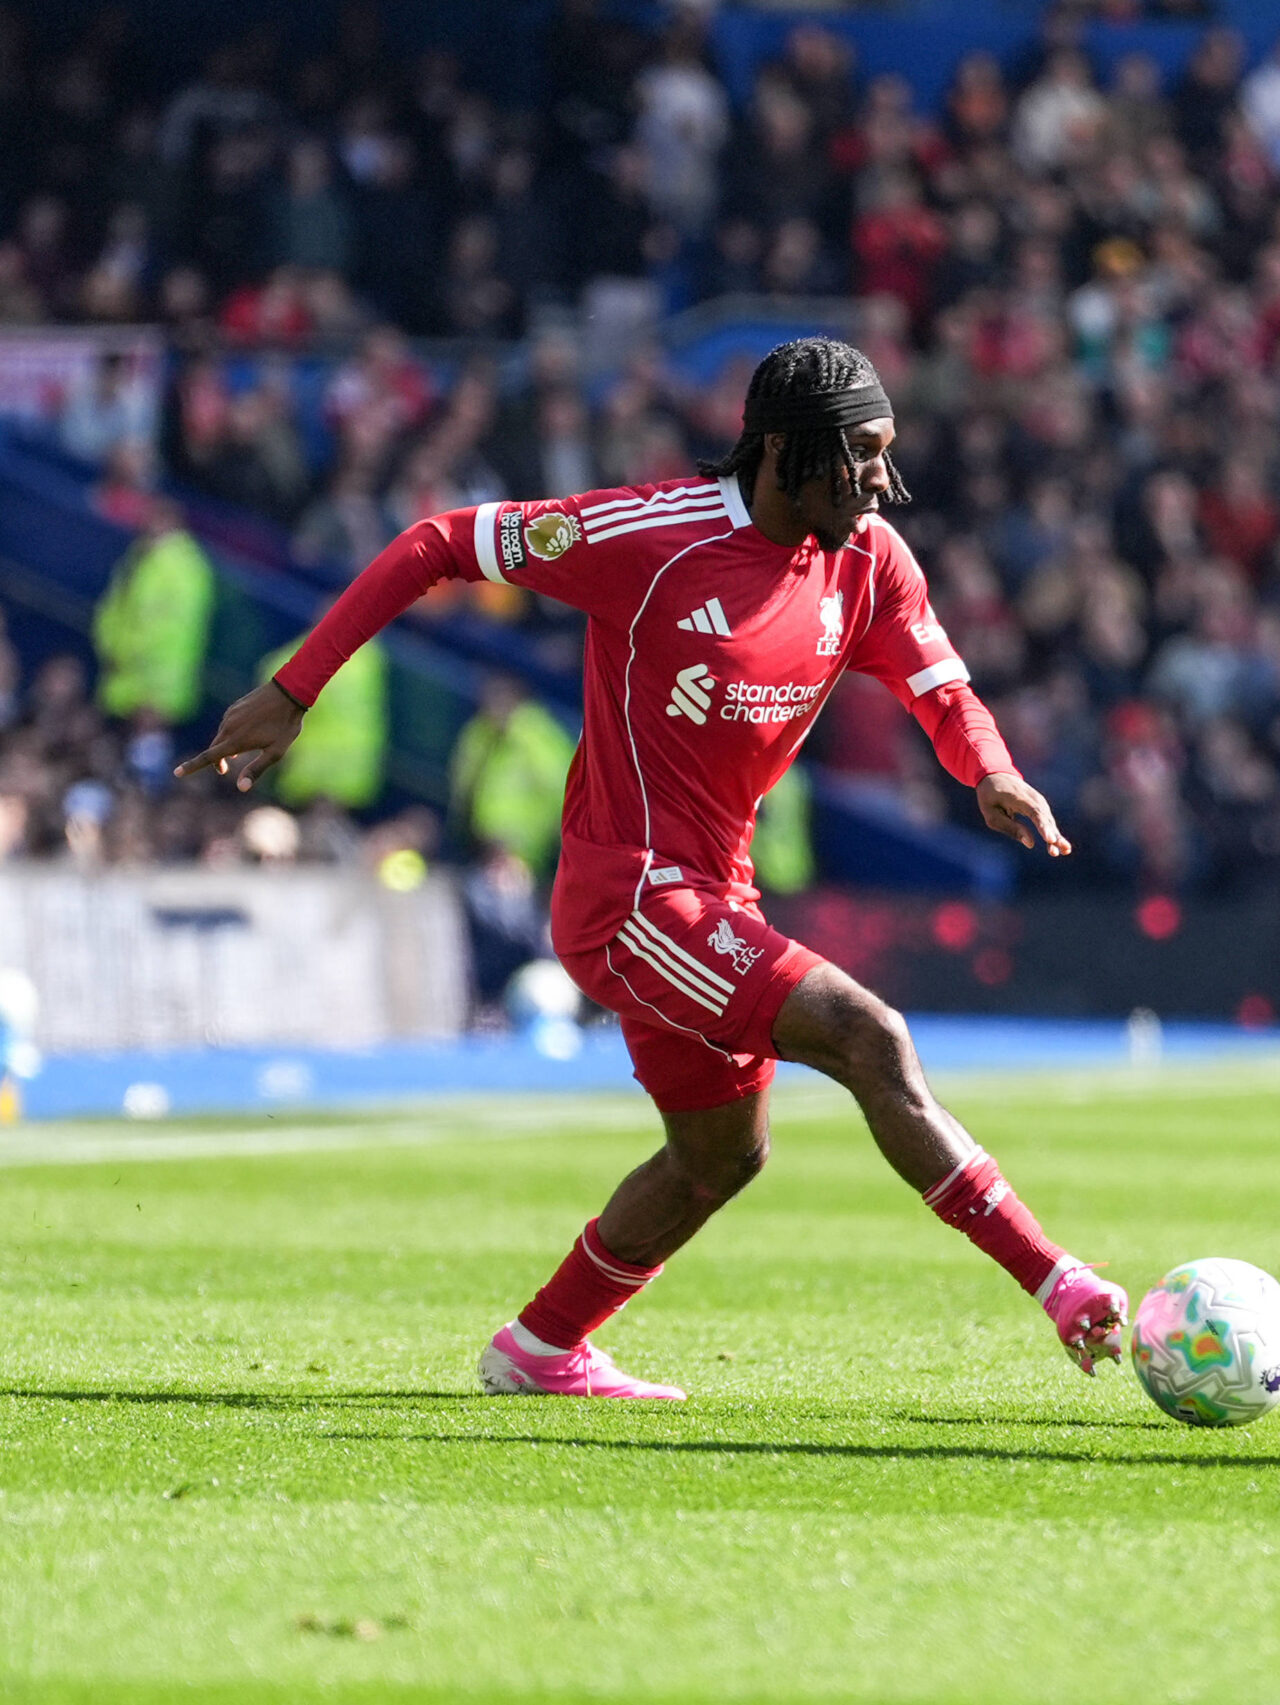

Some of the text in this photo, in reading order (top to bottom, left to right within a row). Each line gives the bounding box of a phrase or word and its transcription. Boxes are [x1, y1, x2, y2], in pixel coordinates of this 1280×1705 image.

[500, 512, 515, 571] for racism
[509, 511, 524, 563] No room
[725, 679, 826, 703] standard
